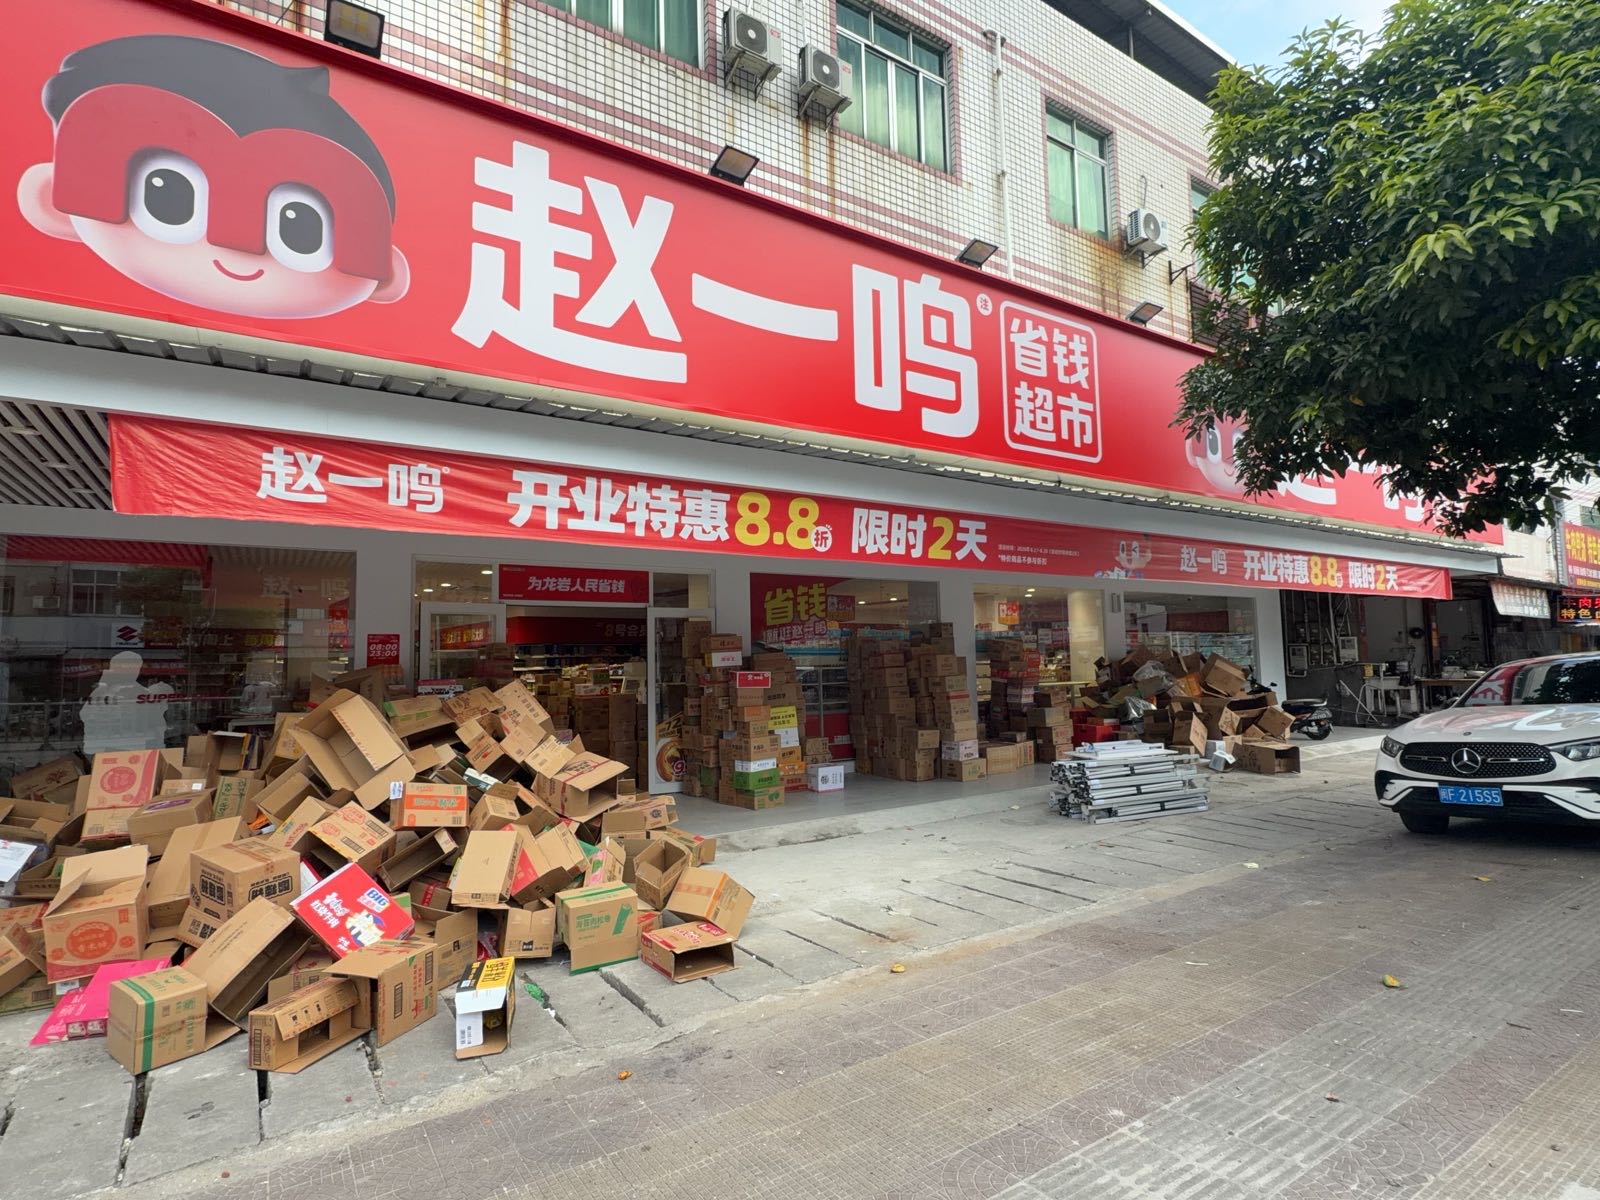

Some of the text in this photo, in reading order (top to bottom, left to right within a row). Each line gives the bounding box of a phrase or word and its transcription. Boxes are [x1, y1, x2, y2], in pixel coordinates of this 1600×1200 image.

[450, 140, 980, 439] 赵一鸣
[1010, 317, 1089, 390] 省钱
[1014, 381, 1094, 448] 超市
[256, 446, 445, 513] 赵一鸣
[851, 507, 987, 562] 限时2天
[527, 576, 625, 594] 为龙岩人民省钱
[1180, 546, 1228, 575] 赵一鸣
[1348, 561, 1399, 591] 限时2天
[764, 583, 827, 626] 省钱
[367, 889, 388, 906] BIG
